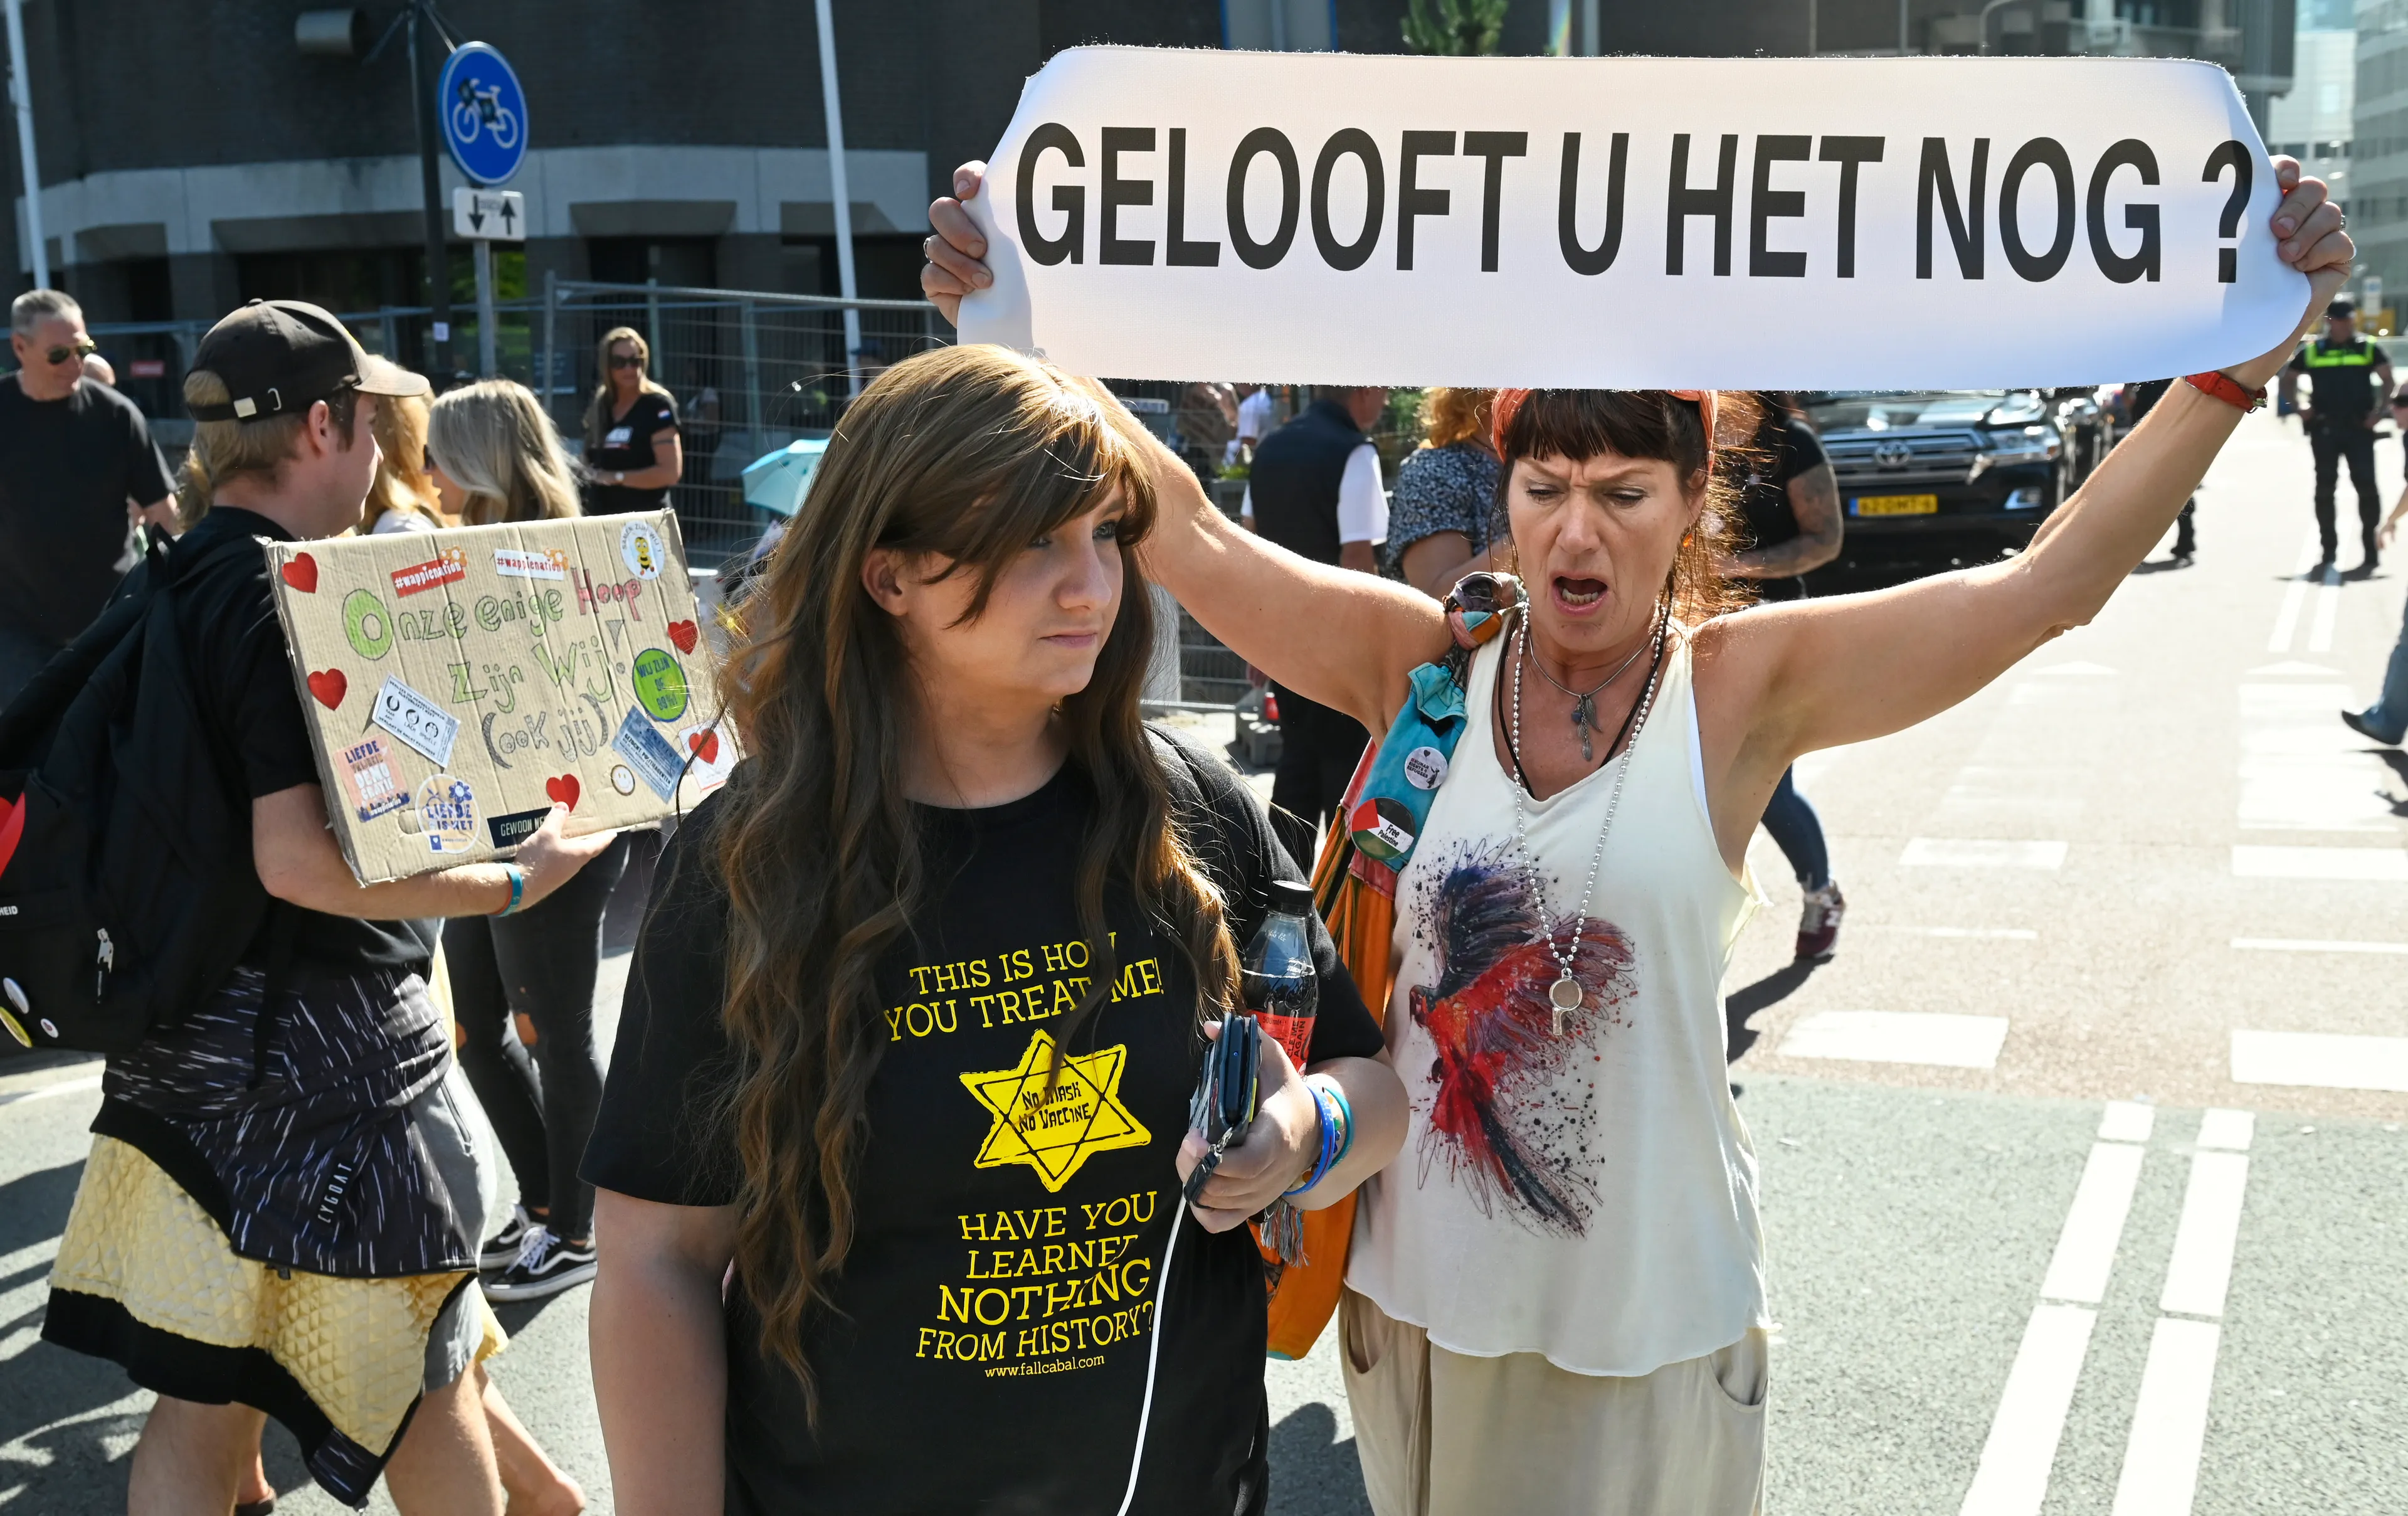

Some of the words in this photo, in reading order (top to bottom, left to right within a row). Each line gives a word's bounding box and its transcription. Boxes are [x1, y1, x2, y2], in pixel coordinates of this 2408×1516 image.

[1016, 122, 1528, 272] GELOOFT
[1558, 132, 1629, 275] U
[1666, 134, 1885, 278] HET
[1916, 137, 2162, 284] NOG
[2201, 140, 2254, 284] ?
[394, 560, 462, 590] #wappienation
[497, 556, 561, 573] #wappienation
[342, 588, 468, 660] Onze
[474, 588, 563, 637] enige
[571, 568, 642, 621] Hoop
[447, 661, 524, 713] Zijn
[345, 740, 379, 763] LIEFDE
[1407, 765, 1428, 778] REFUGEES
[500, 819, 532, 837] GEWOON
[534, 816, 546, 829] NE
[1377, 829, 1398, 847] Palestine
[1386, 824, 1400, 838] Free
[910, 959, 991, 995] THIS
[998, 948, 1034, 984] IS
[1040, 931, 1117, 973] HO
[884, 999, 960, 1042] YOU
[971, 976, 1092, 1029] TREAT
[1111, 957, 1164, 1004] ME!
[1292, 1020, 1299, 1036] ME
[1294, 1020, 1306, 1057] AGAIN
[1018, 1113, 1037, 1133] NO
[1038, 1103, 1092, 1129] VACCINE
[958, 1207, 1067, 1241] HAVE
[1080, 1190, 1158, 1230] YOU
[937, 1257, 1151, 1325] NOTHING
[915, 1327, 1006, 1362] FROM
[1016, 1300, 1154, 1358] HISTORY?
[985, 1354, 1105, 1377] www.fallcabal.com
